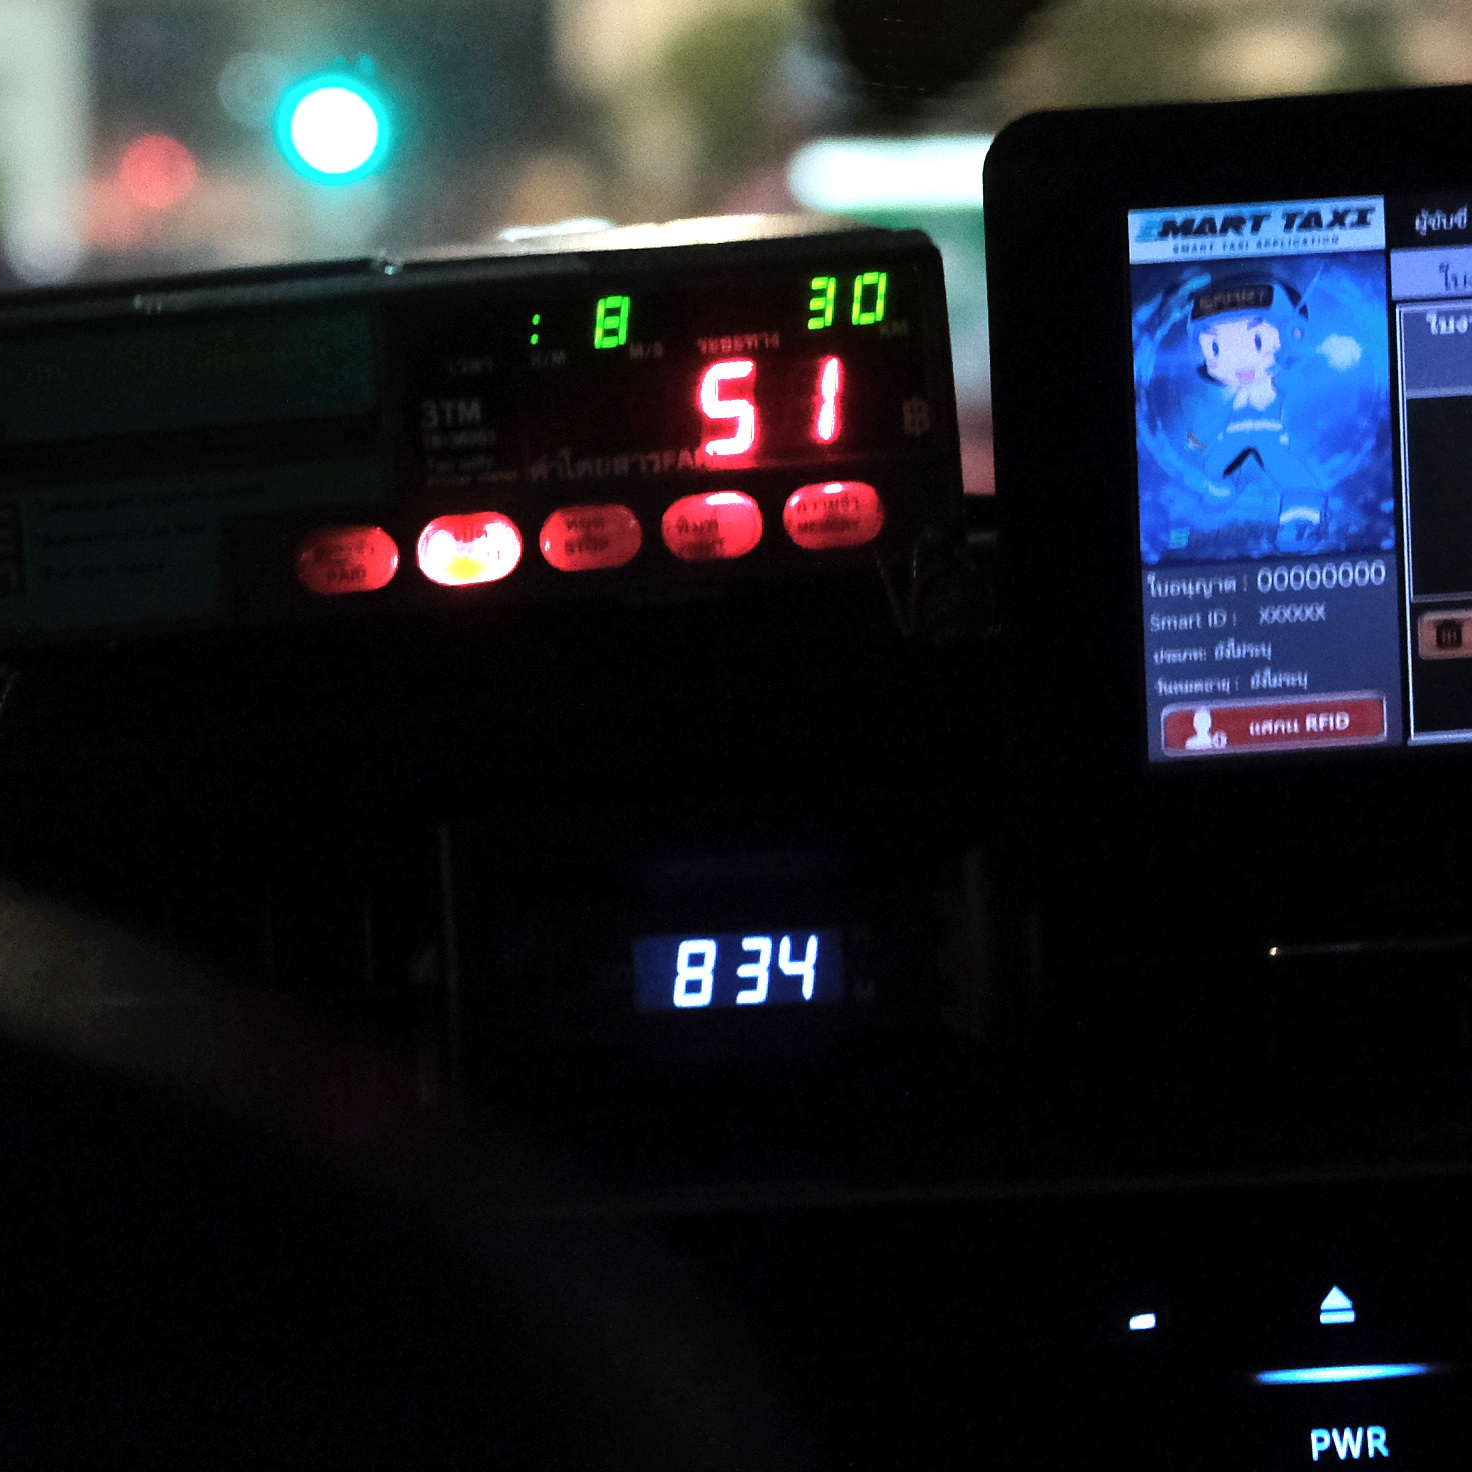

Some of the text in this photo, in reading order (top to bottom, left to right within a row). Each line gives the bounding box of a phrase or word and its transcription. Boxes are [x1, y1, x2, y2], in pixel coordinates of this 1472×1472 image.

[1282, 206, 1375, 232] TAXI
[807, 271, 889, 331] 30
[1257, 559, 1386, 594] 00000000
[1149, 609, 1202, 632] Smart
[1207, 607, 1227, 629] ID
[1305, 710, 1351, 734] RFID
[1311, 1425, 1390, 1462] PWR
